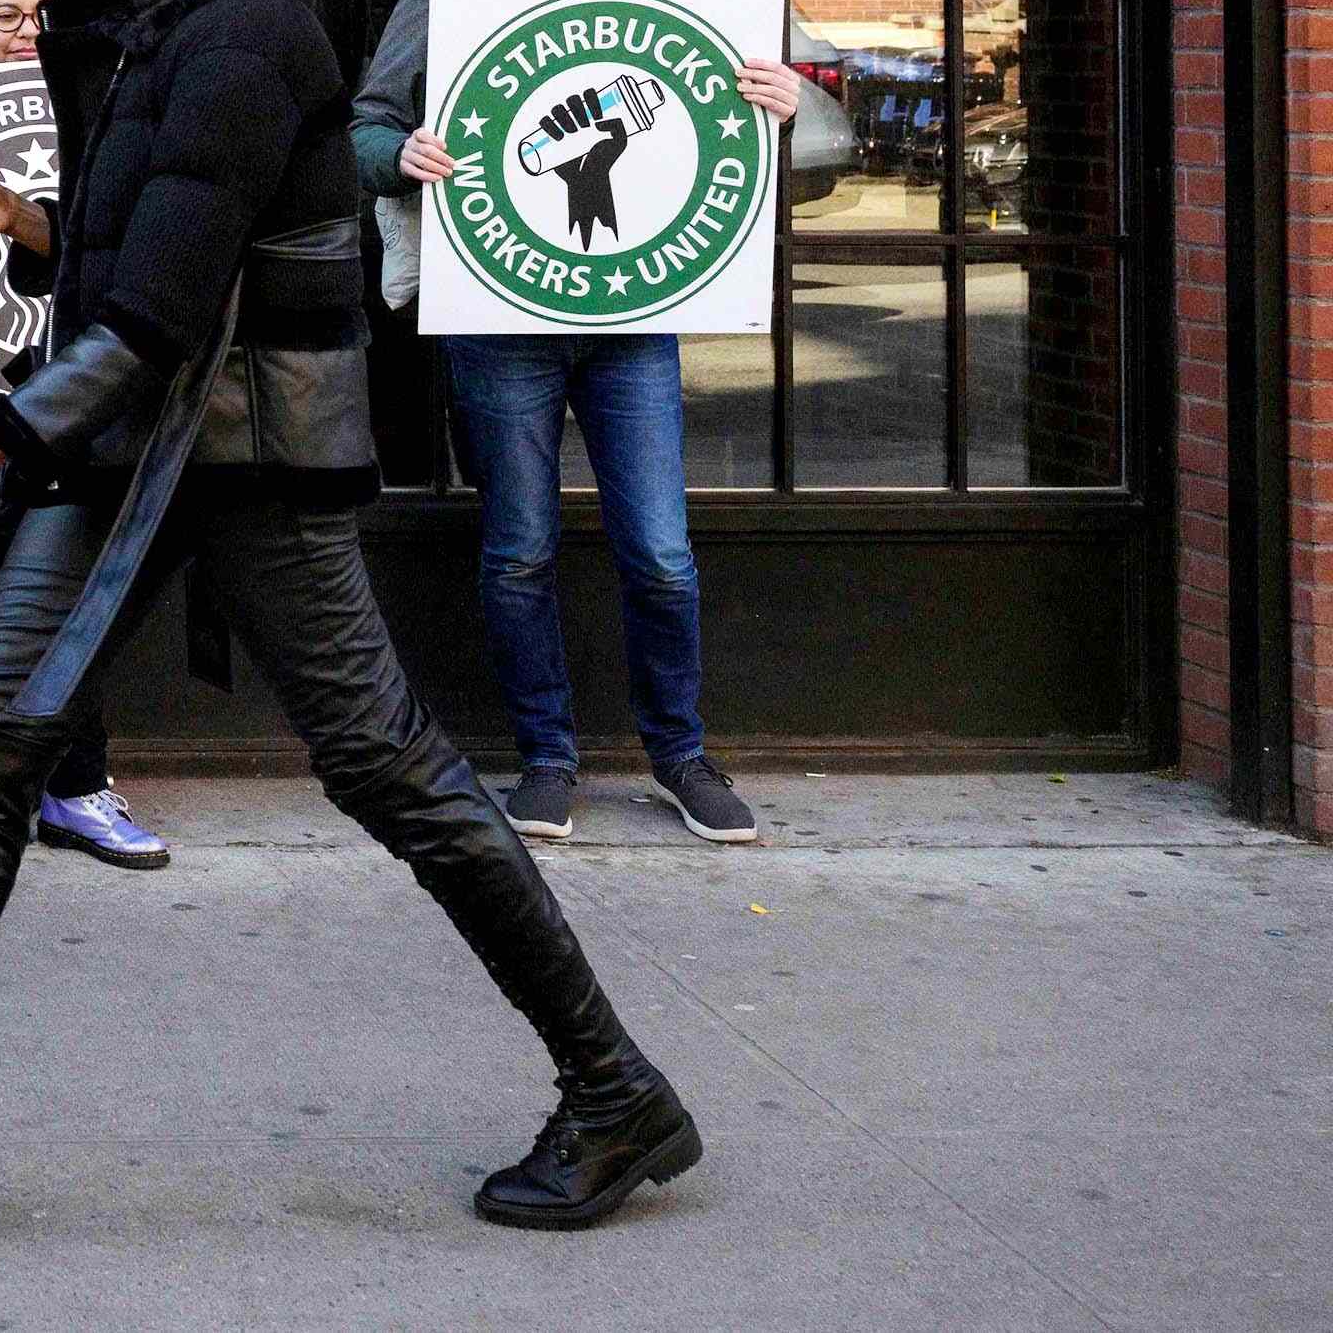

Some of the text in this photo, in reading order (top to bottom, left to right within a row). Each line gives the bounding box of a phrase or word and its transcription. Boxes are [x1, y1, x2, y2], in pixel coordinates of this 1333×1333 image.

[486, 15, 729, 106] STARBUCKS
[452, 149, 593, 299] WORKERS
[634, 156, 747, 286] UNITED
